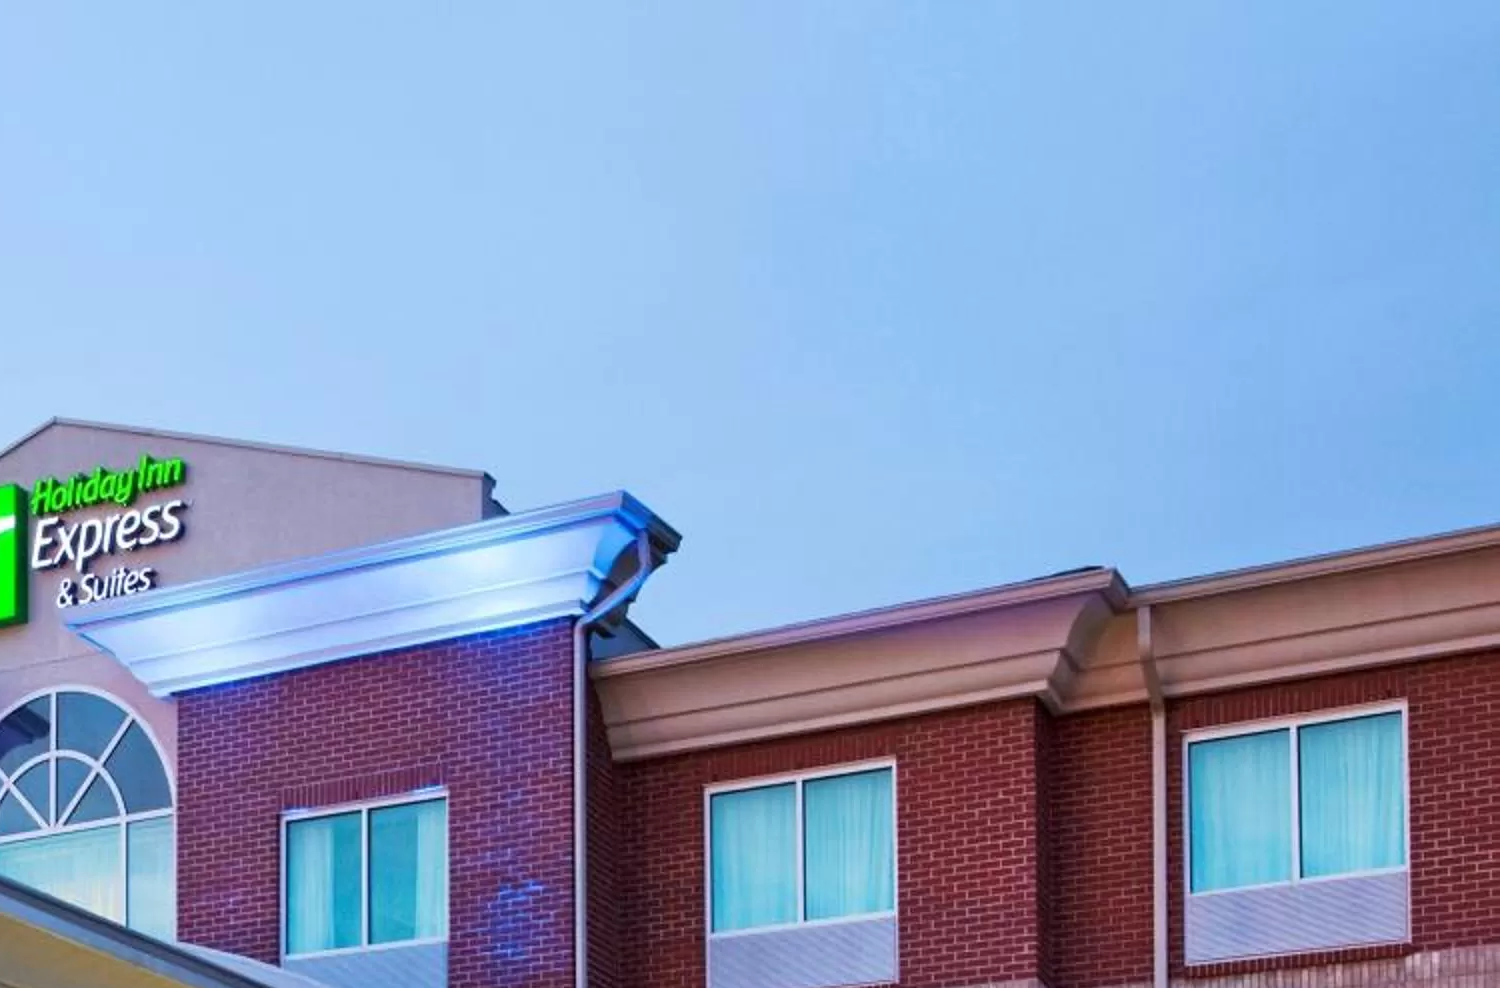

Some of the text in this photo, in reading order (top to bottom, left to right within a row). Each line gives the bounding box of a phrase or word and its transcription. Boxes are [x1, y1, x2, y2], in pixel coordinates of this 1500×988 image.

[30, 455, 187, 516] Holiday Inn
[31, 500, 186, 572] Express
[56, 566, 155, 608] & Suites
